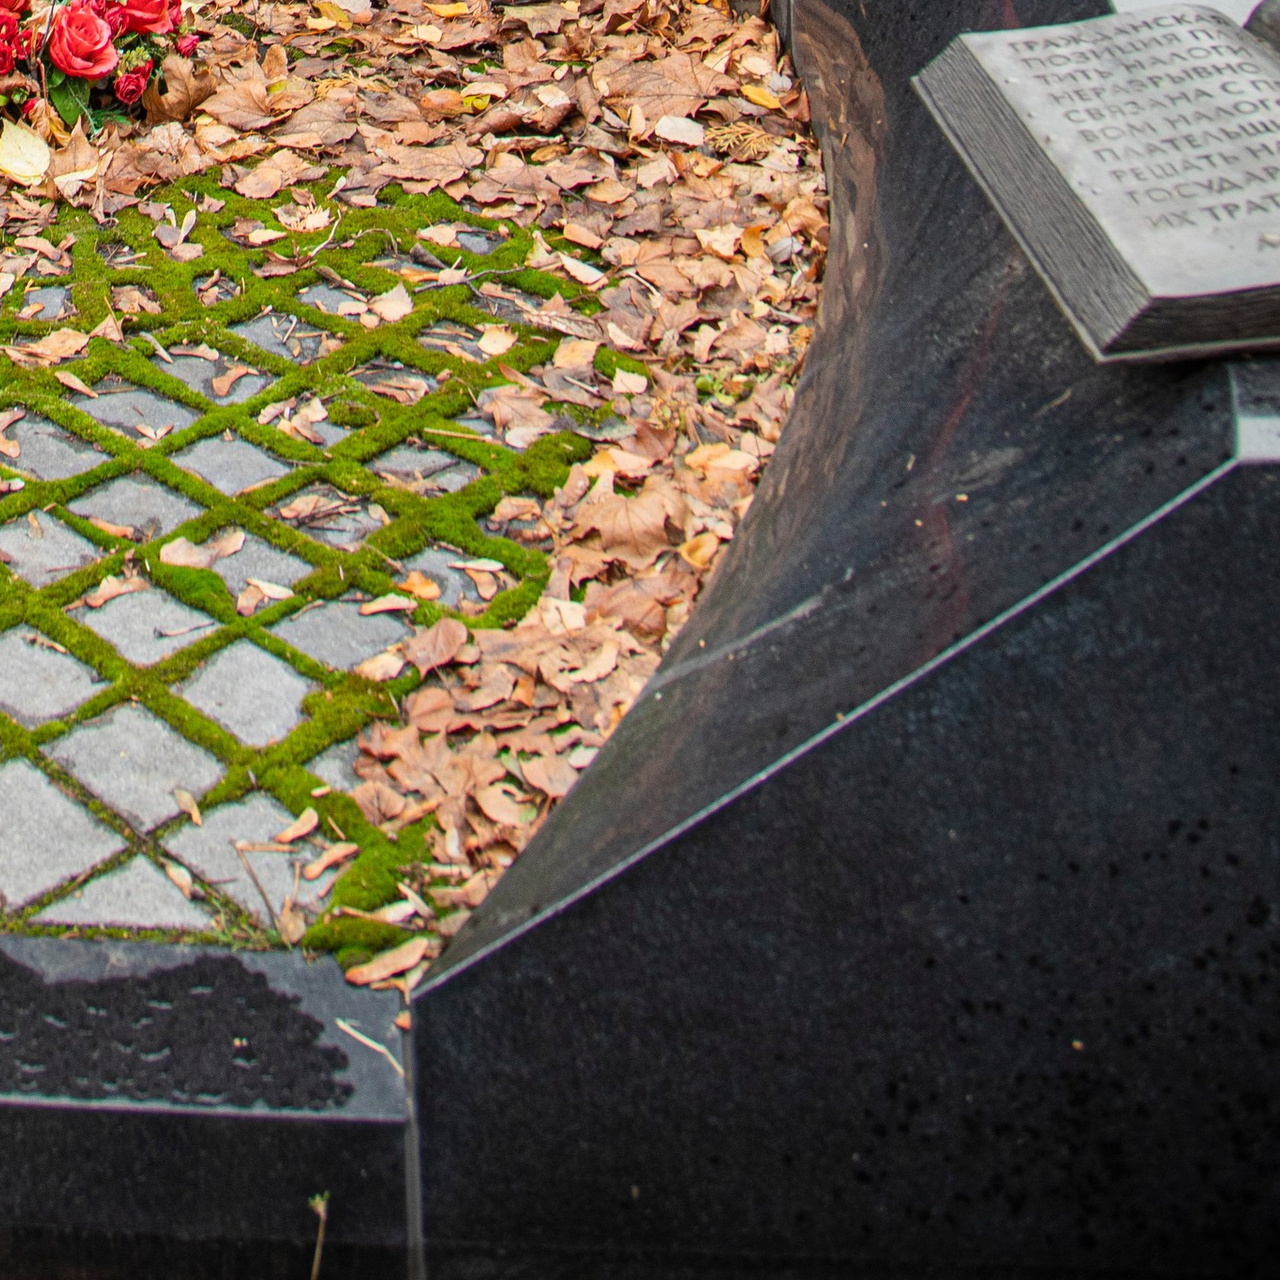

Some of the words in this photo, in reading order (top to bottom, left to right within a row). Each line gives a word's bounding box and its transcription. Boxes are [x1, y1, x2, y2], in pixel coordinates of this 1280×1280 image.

[1021, 33, 1181, 69] ПОЗИЦИЯ
[1121, 45, 1252, 74] НАЛОГИ
[1048, 62, 1260, 104] НЕРАЗРЫВНО
[1063, 88, 1214, 123] СВЯЗАНА
[1220, 81, 1245, 95] С
[1078, 120, 1157, 143] ВОМ
[1110, 151, 1240, 182] РЕШАТЬ
